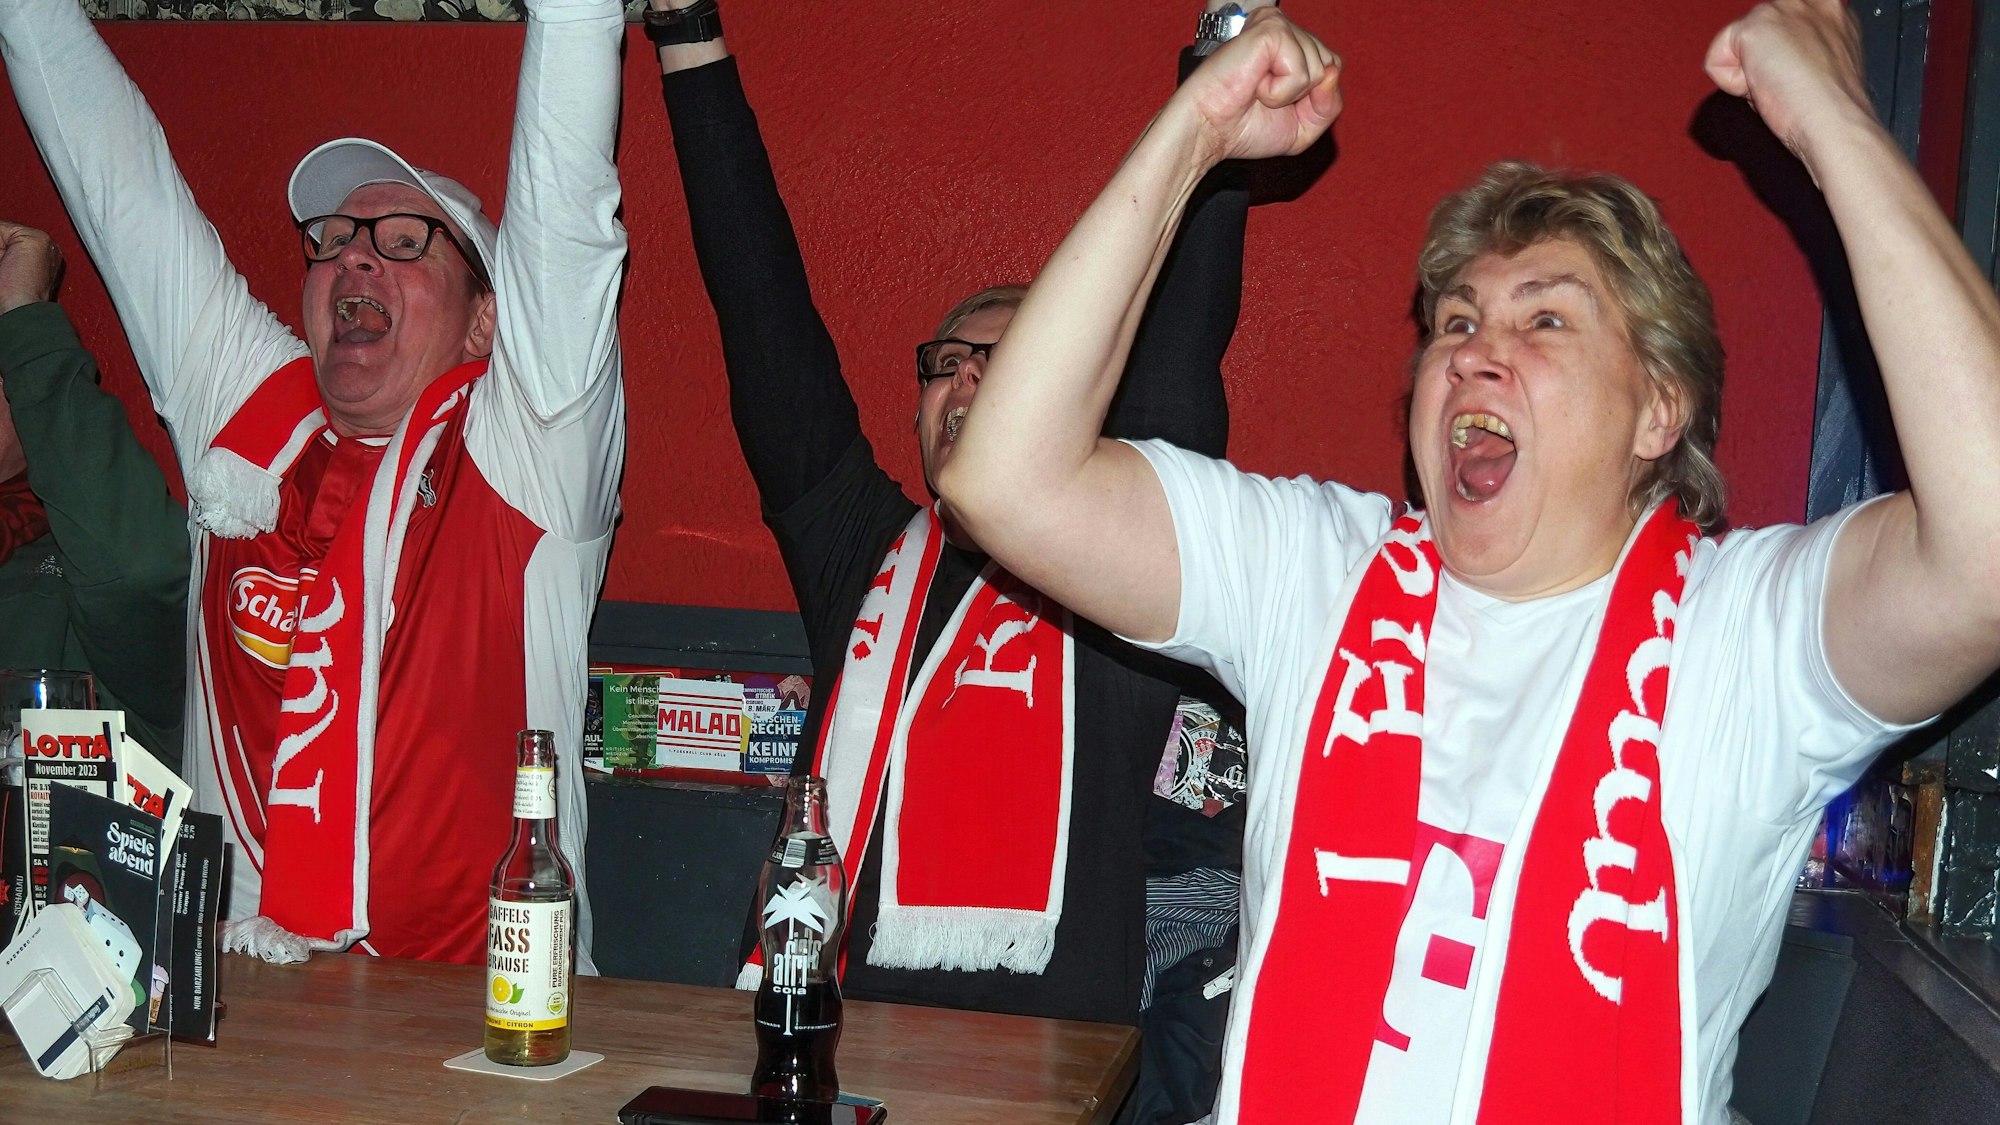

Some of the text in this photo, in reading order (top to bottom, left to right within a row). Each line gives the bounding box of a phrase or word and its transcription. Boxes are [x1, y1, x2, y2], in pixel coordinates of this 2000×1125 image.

[610, 685, 660, 693] Kein Mensch
[626, 697, 659, 707] ist illega
[756, 704, 775, 712] MÄRZ
[750, 724, 801, 735] RECHTE
[23, 729, 112, 758] LOTTA
[36, 763, 98, 777] November 2023
[107, 821, 155, 856] Spiele
[109, 846, 154, 876] abend
[489, 904, 530, 924] GAFFELS
[488, 923, 530, 953] FASS
[194, 949, 203, 994] BARZAHLUNG!
[488, 953, 529, 973] BRAUSE
[773, 941, 807, 987] afri
[773, 986, 807, 995] cola
